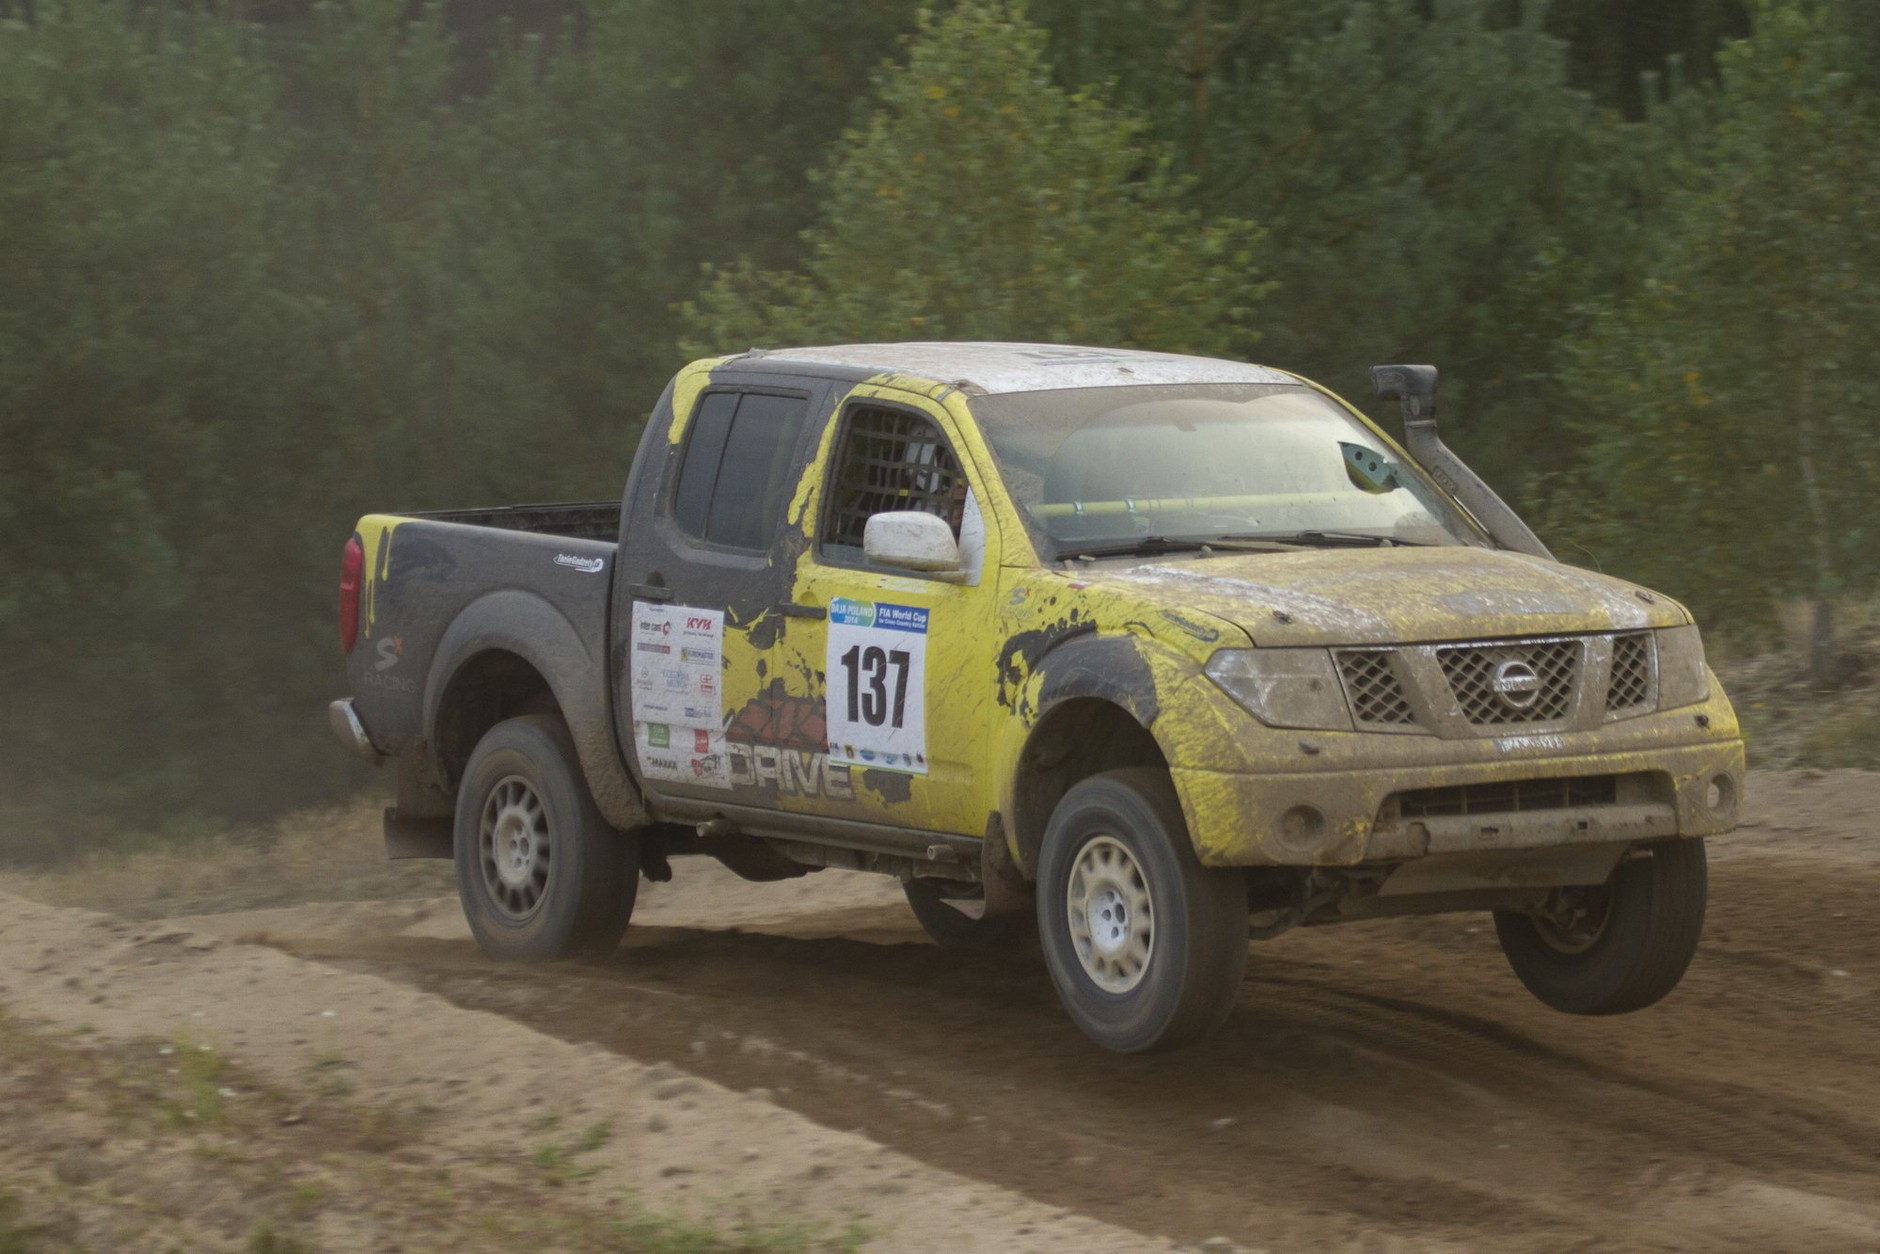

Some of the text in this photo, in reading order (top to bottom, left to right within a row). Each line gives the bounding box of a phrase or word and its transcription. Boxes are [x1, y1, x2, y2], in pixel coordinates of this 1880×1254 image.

[830, 603, 873, 617] BAJA POLAND
[878, 607, 927, 623] FIA World Cup
[686, 617, 713, 630] KYB
[841, 645, 910, 729] 137
